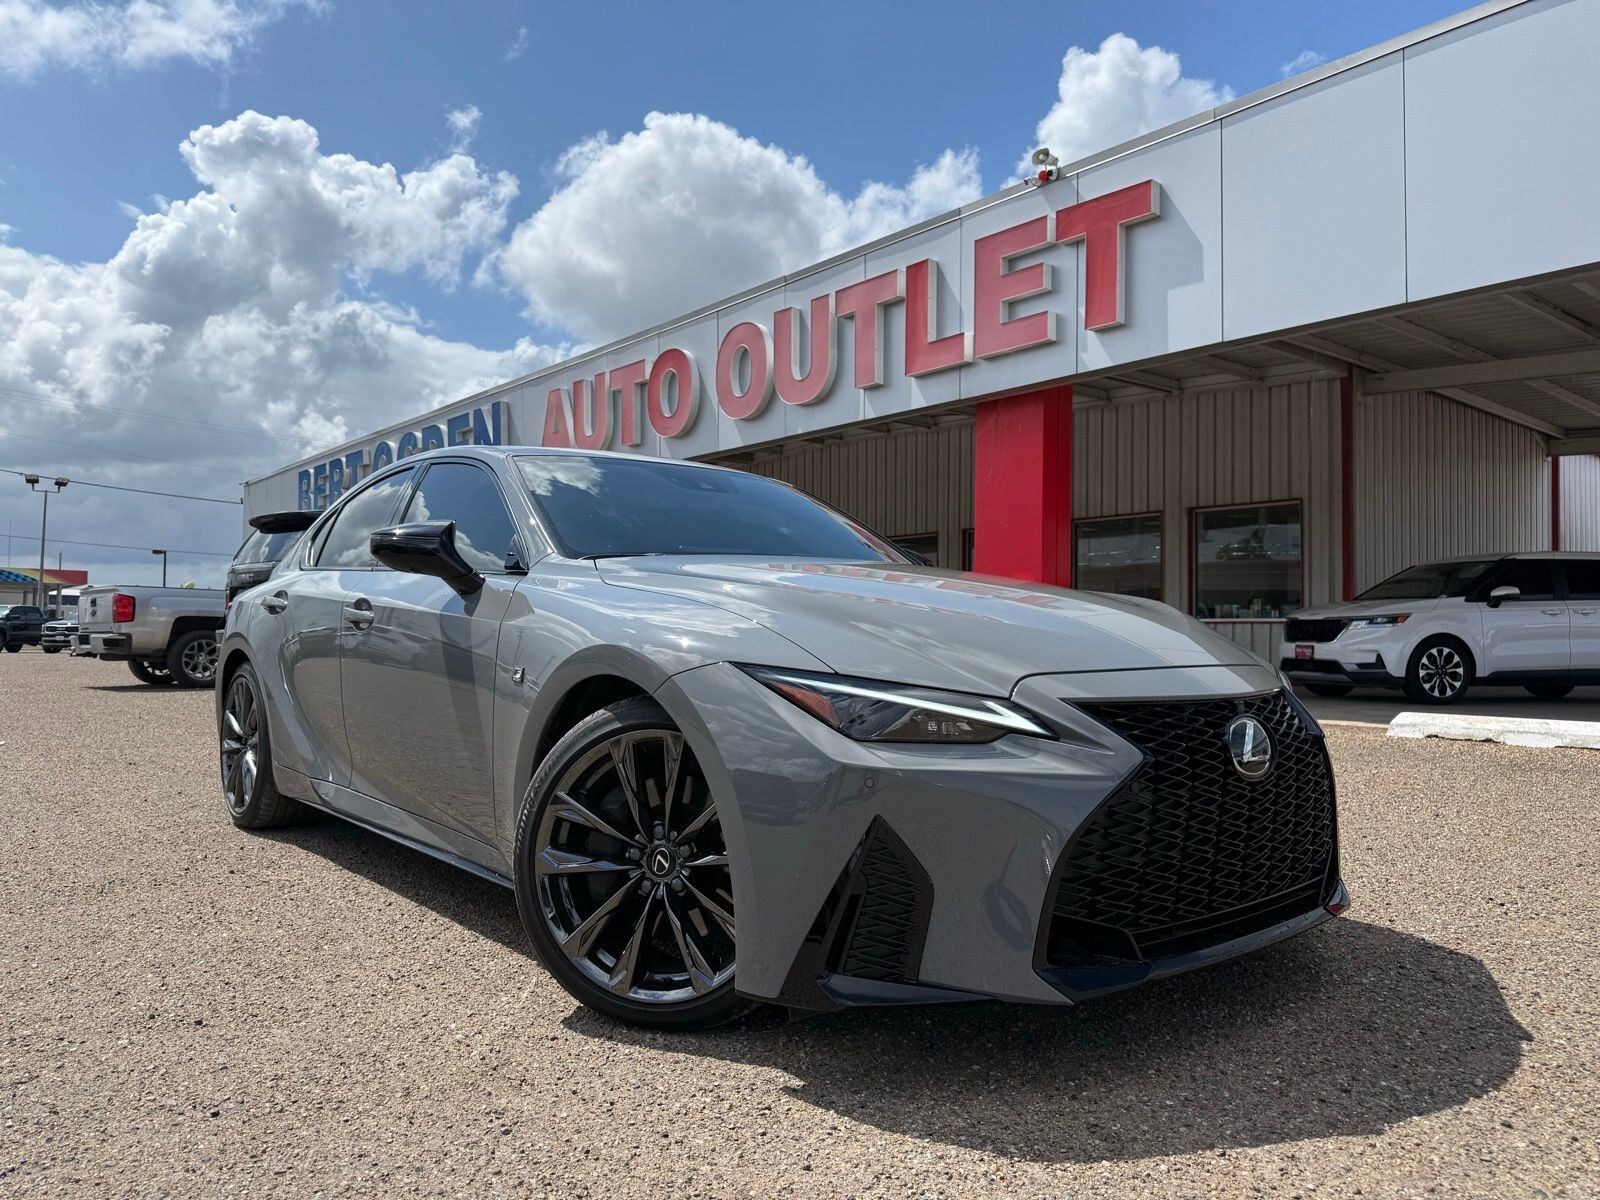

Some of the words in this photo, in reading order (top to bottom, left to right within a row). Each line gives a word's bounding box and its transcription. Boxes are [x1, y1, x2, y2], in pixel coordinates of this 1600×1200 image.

[297, 449, 366, 511] BERT
[541, 348, 699, 449] AUTO
[716, 178, 1161, 420] OUTLET
